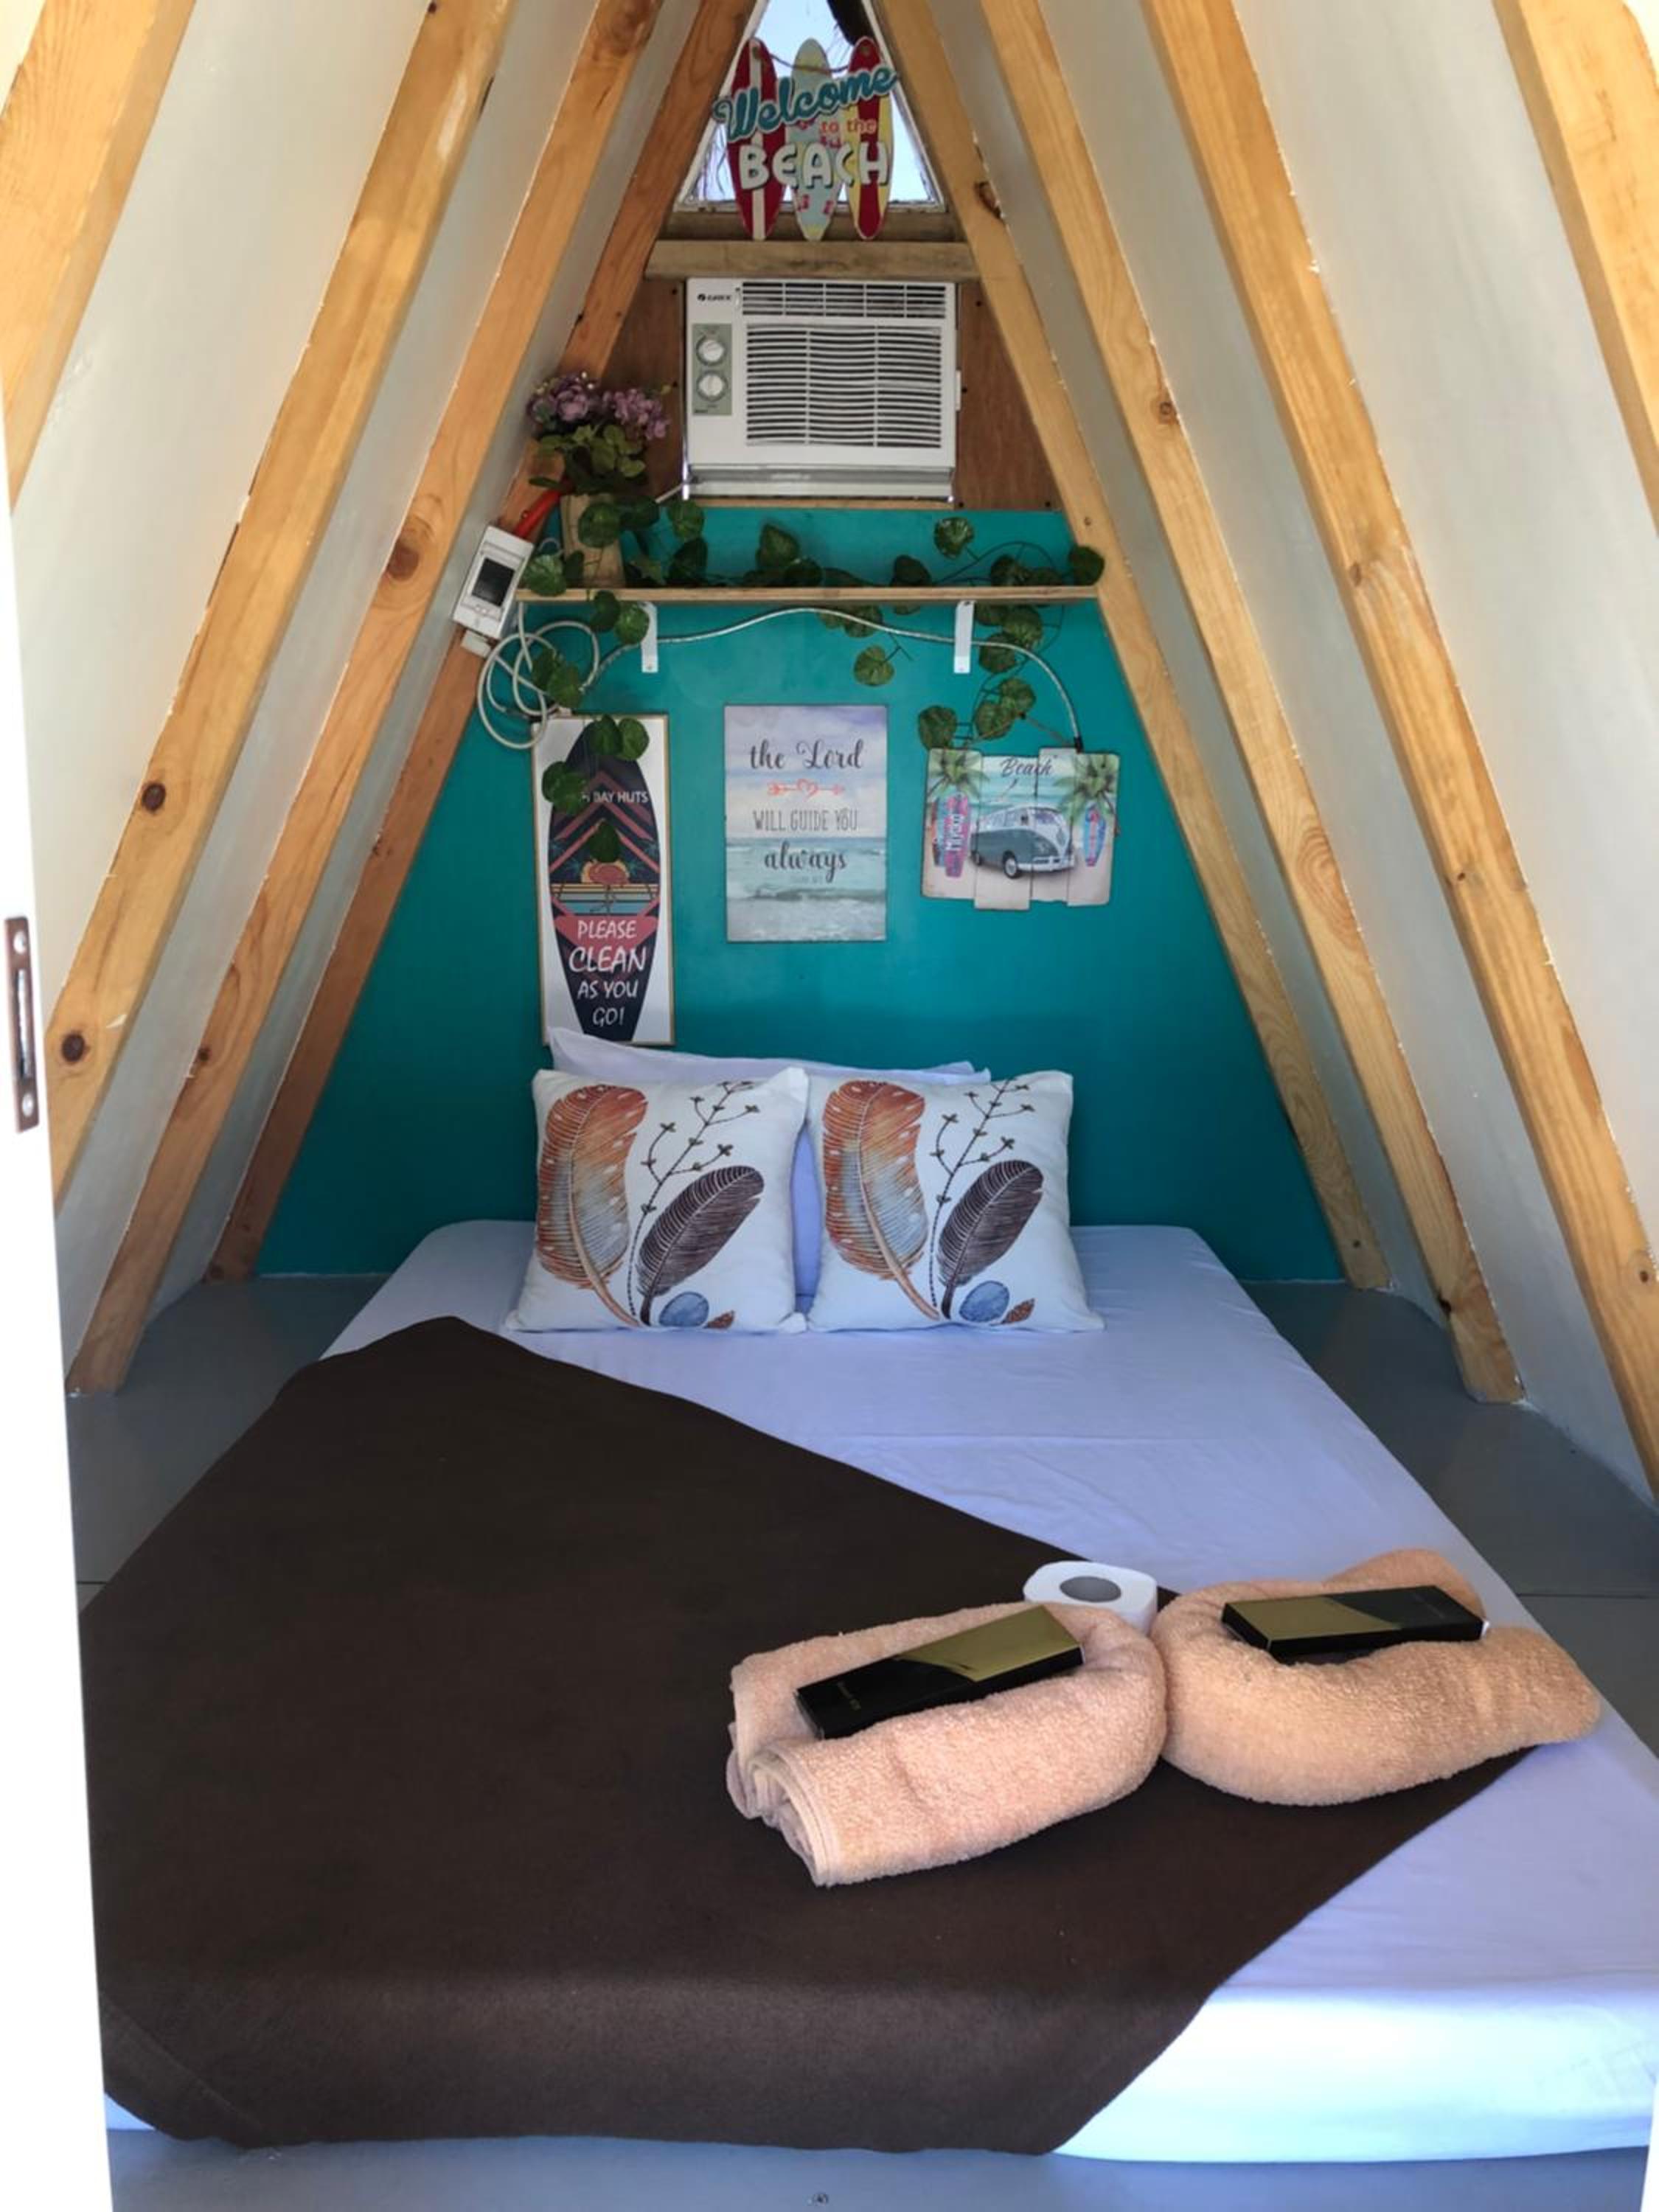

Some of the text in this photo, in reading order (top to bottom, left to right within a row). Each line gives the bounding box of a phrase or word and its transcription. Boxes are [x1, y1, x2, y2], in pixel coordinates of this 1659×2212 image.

[713, 66, 897, 141] Welcome
[821, 118, 877, 134] to the
[739, 142, 888, 189] BEACH
[750, 739, 863, 769] the Lord
[1000, 756, 1052, 778] Beach
[617, 791, 649, 803] HUTS
[753, 810, 858, 831] WILL GUIDE YOU
[764, 841, 846, 883] always
[577, 920, 637, 939] PLEASE
[568, 947, 646, 973] CLEAN
[577, 980, 639, 999] AS YOU
[592, 1007, 625, 1026] GO!
